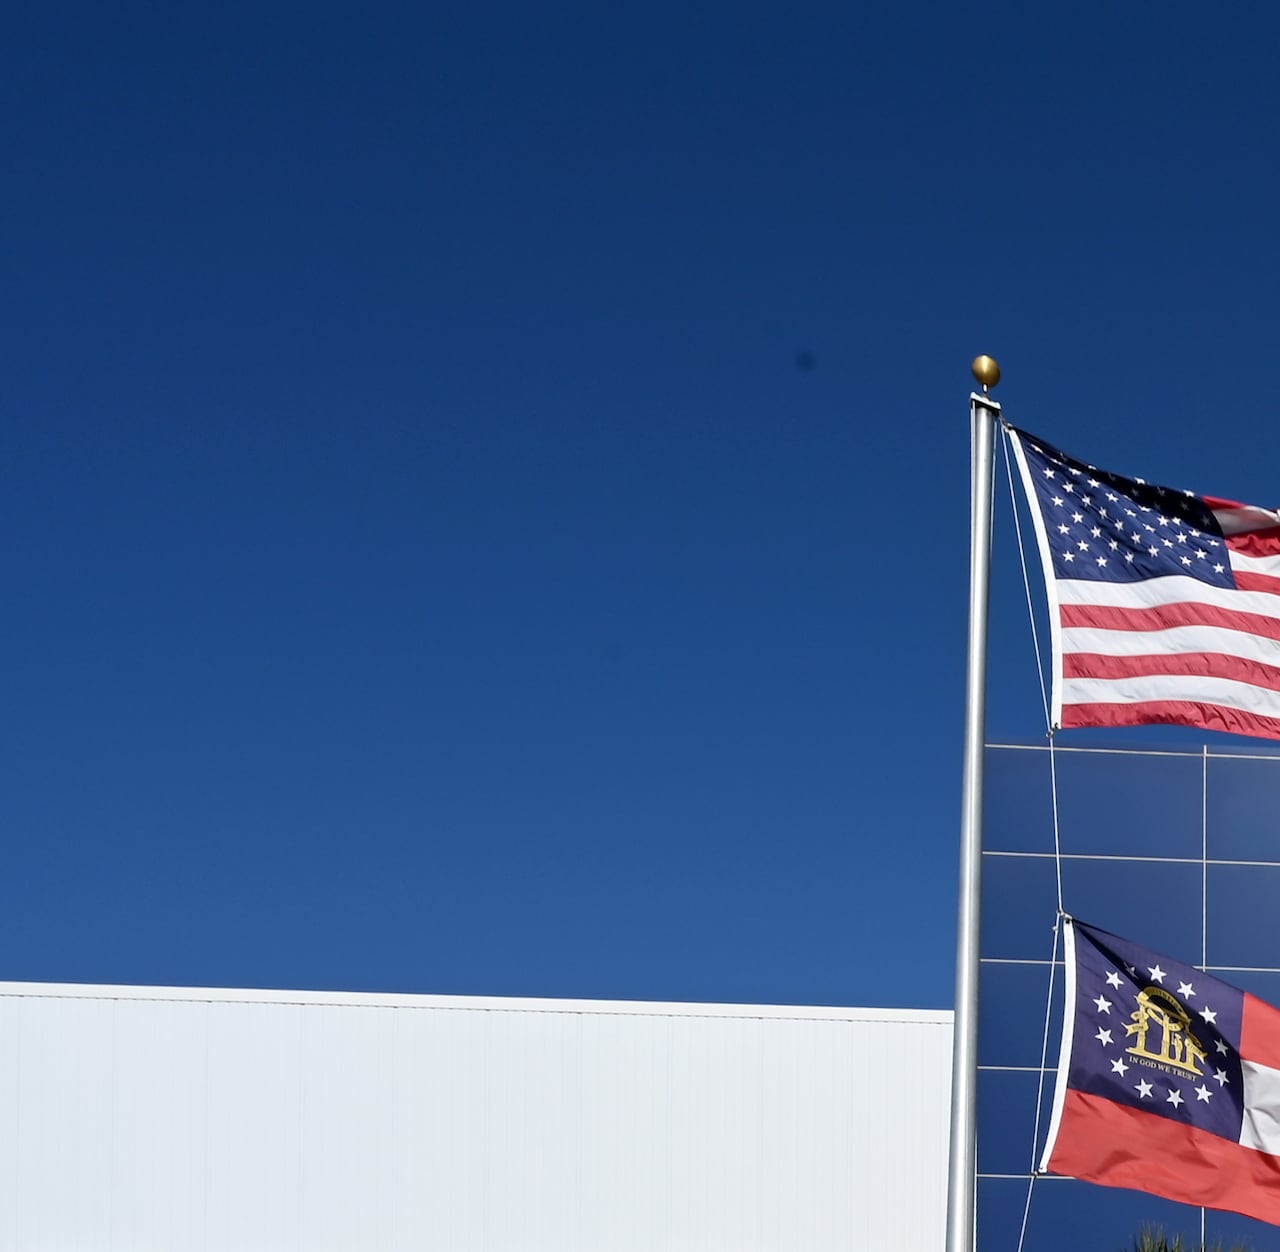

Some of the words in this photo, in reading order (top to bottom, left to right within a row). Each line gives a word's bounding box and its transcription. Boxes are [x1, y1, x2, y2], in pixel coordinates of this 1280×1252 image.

[1129, 1056, 1138, 1064] IN
[1140, 1059, 1156, 1068] GOD
[1158, 1064, 1170, 1073] WE
[1172, 1068, 1196, 1081] TRUST
